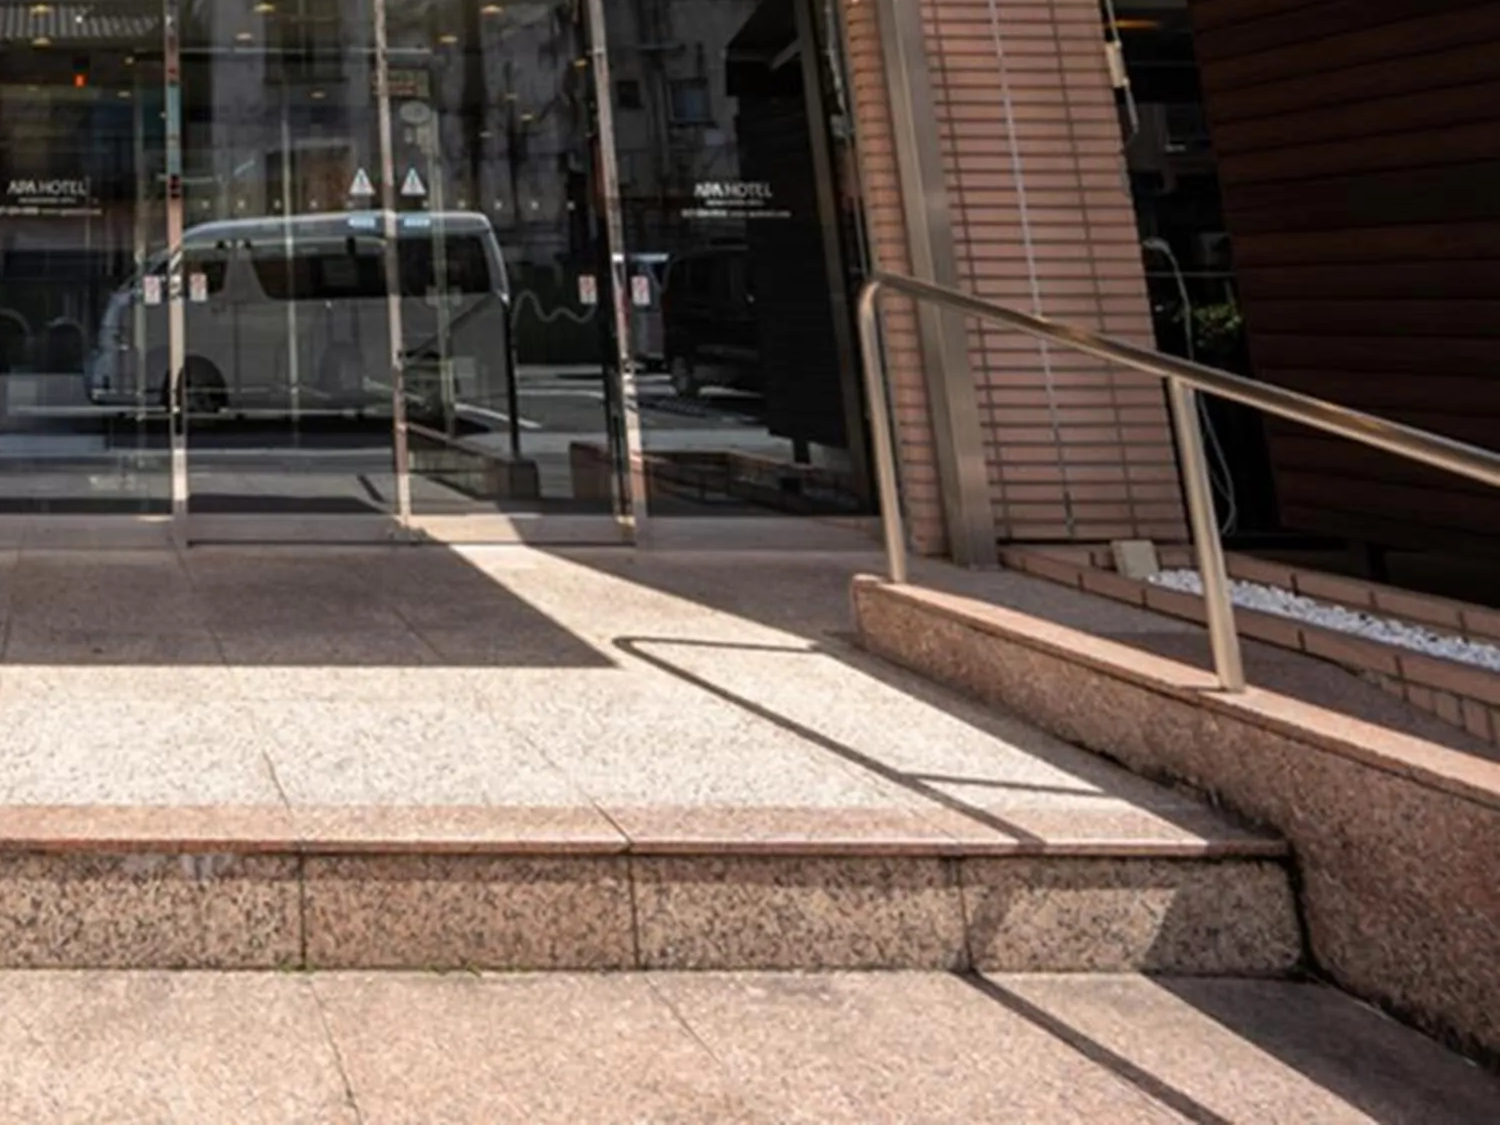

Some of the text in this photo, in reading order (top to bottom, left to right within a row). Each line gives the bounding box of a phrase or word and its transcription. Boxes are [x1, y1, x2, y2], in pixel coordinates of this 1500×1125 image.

[6, 179, 87, 196] APA HOTEL
[693, 182, 773, 198] APA HOTEL
